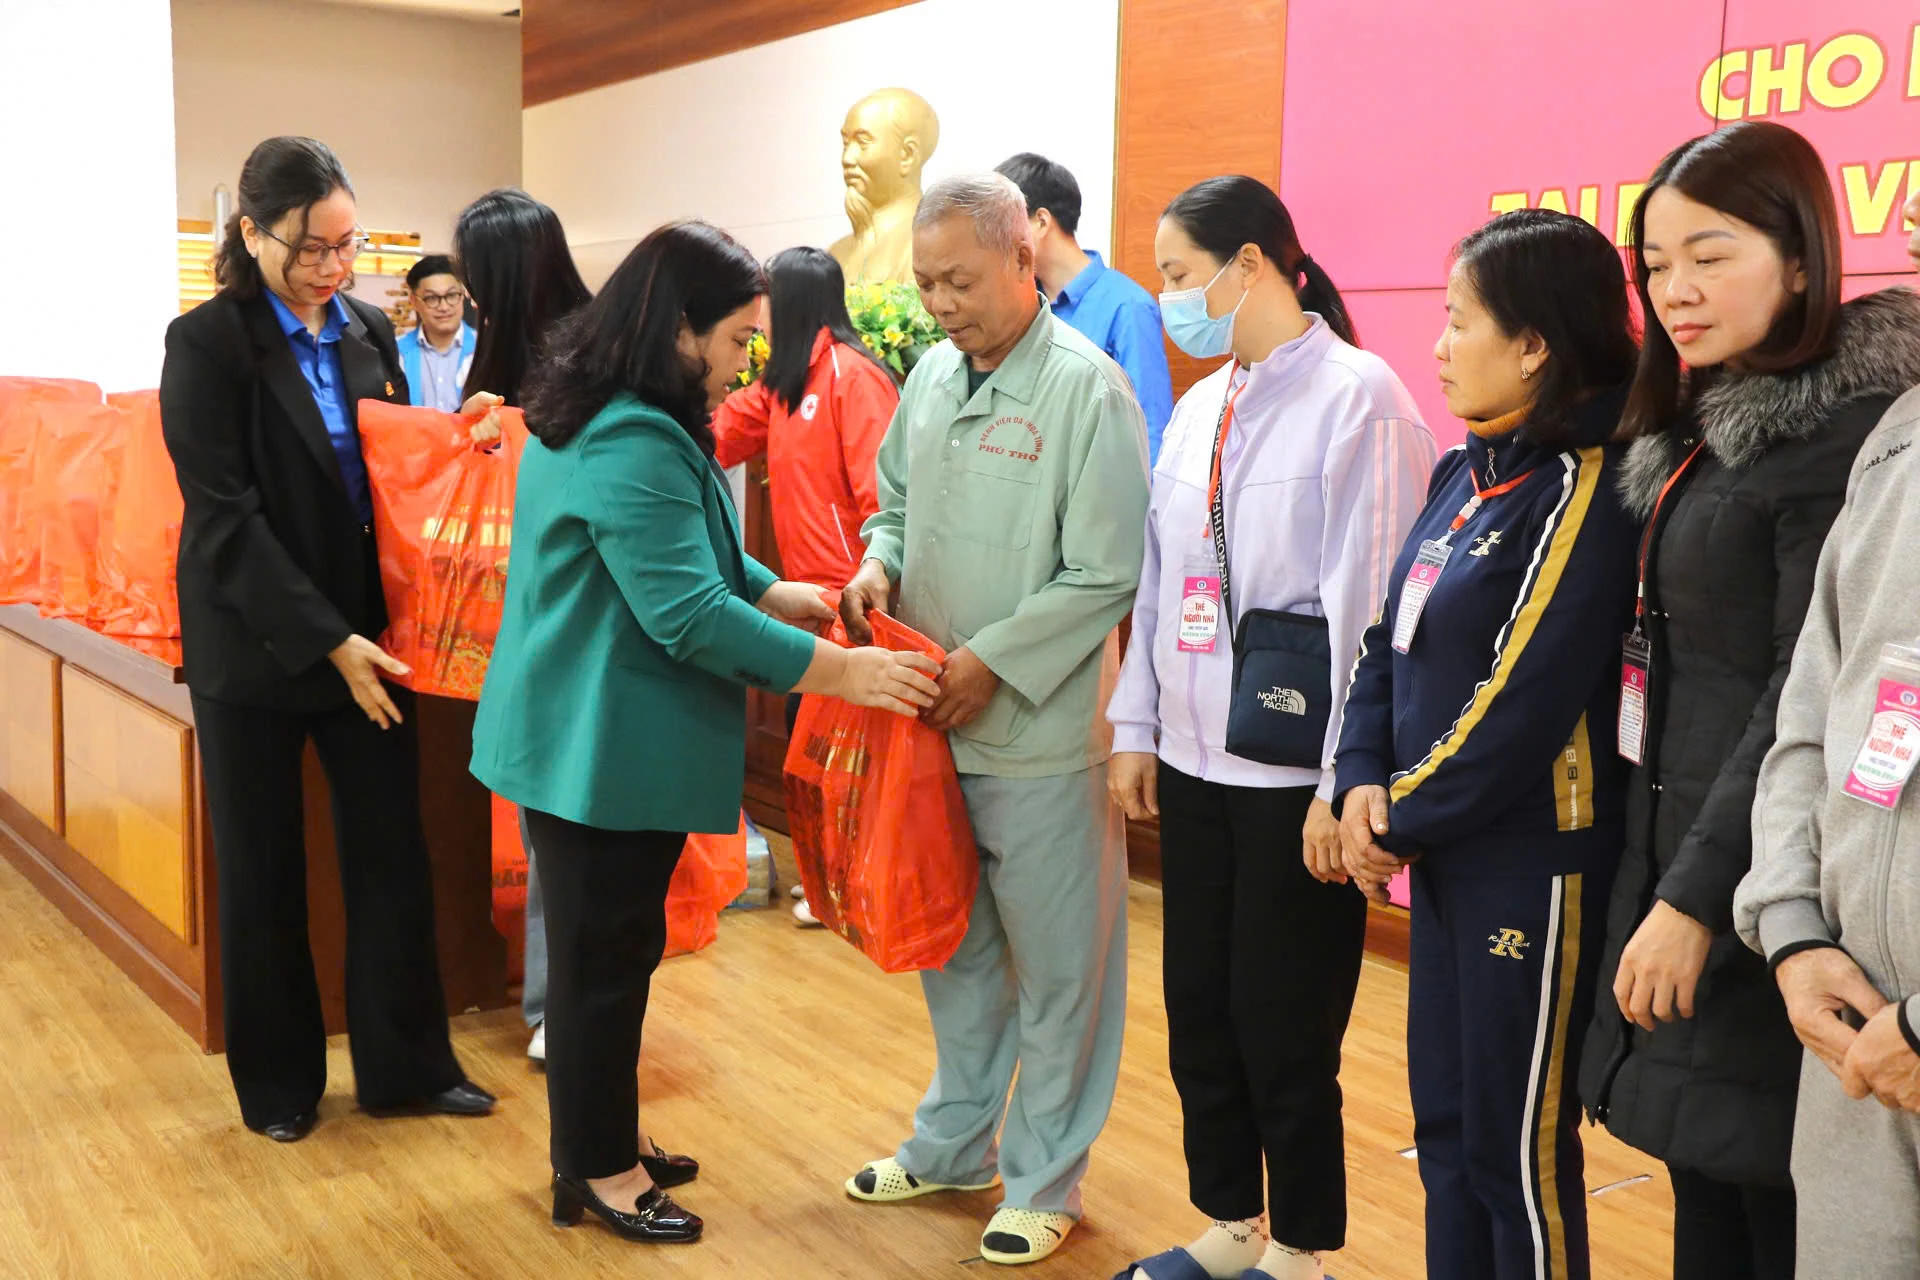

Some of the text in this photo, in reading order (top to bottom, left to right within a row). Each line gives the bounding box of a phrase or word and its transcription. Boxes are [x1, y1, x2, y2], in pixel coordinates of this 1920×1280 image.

[1699, 32, 1885, 121] CHO
[1257, 691, 1291, 705] NORTH
[1271, 686, 1293, 697] THE
[1262, 700, 1290, 713] FACE
